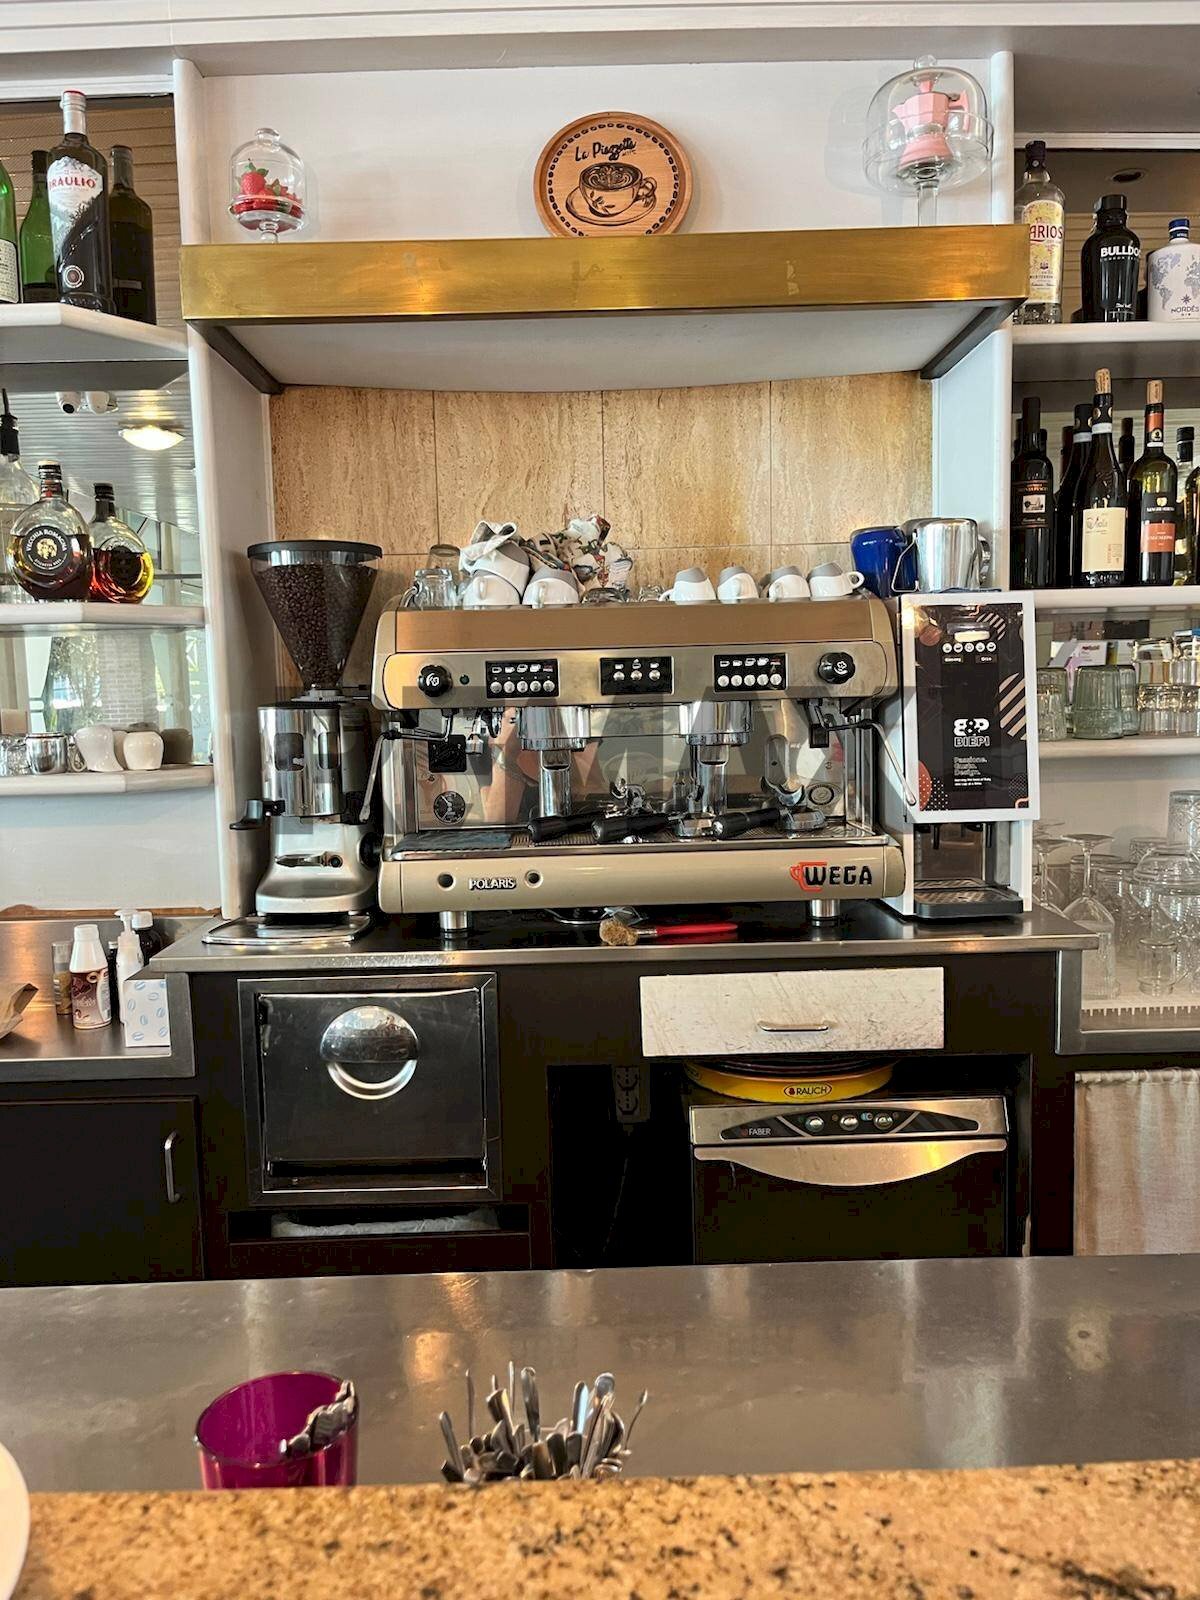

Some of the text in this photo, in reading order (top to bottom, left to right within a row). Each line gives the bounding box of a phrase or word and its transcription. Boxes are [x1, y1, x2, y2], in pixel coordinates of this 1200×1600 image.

[1029, 224, 1063, 240] ARIOS
[804, 865, 872, 885] WEGA
[468, 878, 517, 890] POLARIS
[796, 1086, 828, 1095] RAUCH
[748, 1127, 771, 1136] FABER
